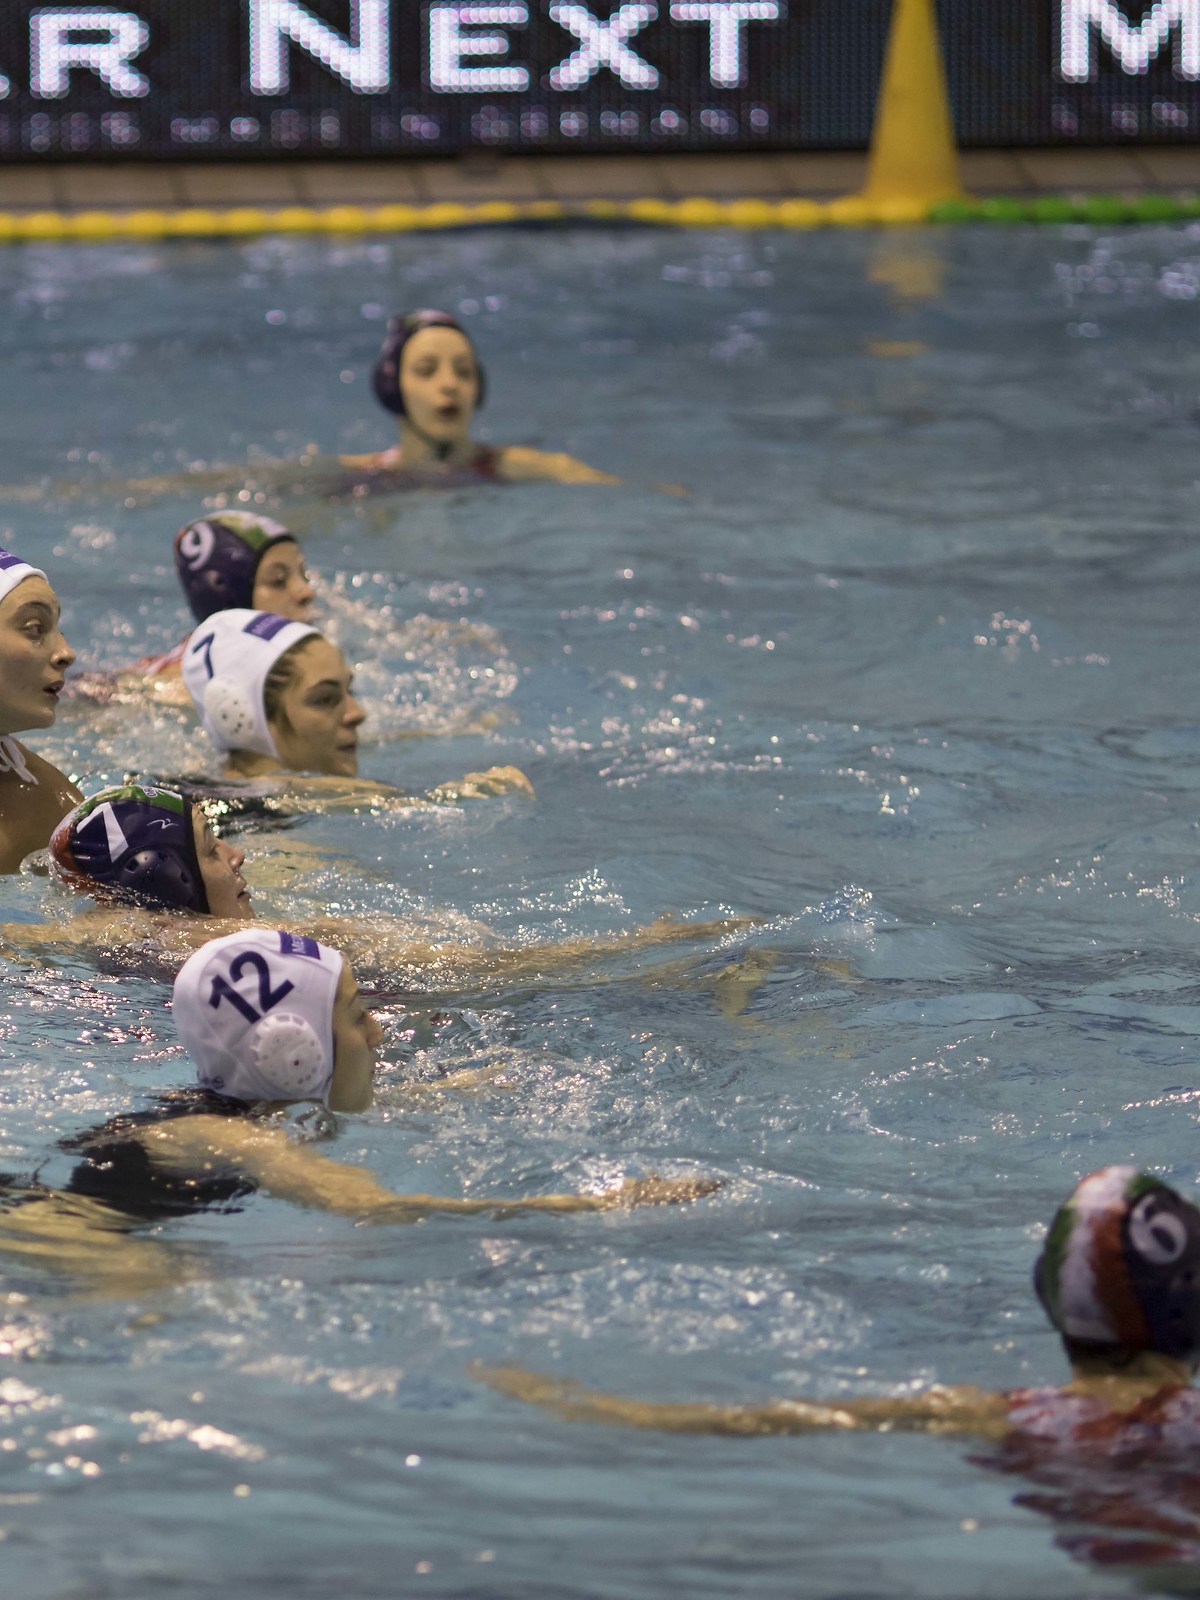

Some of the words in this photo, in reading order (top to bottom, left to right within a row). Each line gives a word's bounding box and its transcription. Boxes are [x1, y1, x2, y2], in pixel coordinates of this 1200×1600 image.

[250, 0, 780, 94] NEXT
[181, 520, 215, 571] 9
[192, 631, 215, 680] 7
[76, 801, 129, 863] 7
[208, 951, 295, 1024] 12
[1129, 1194, 1187, 1264] 6
